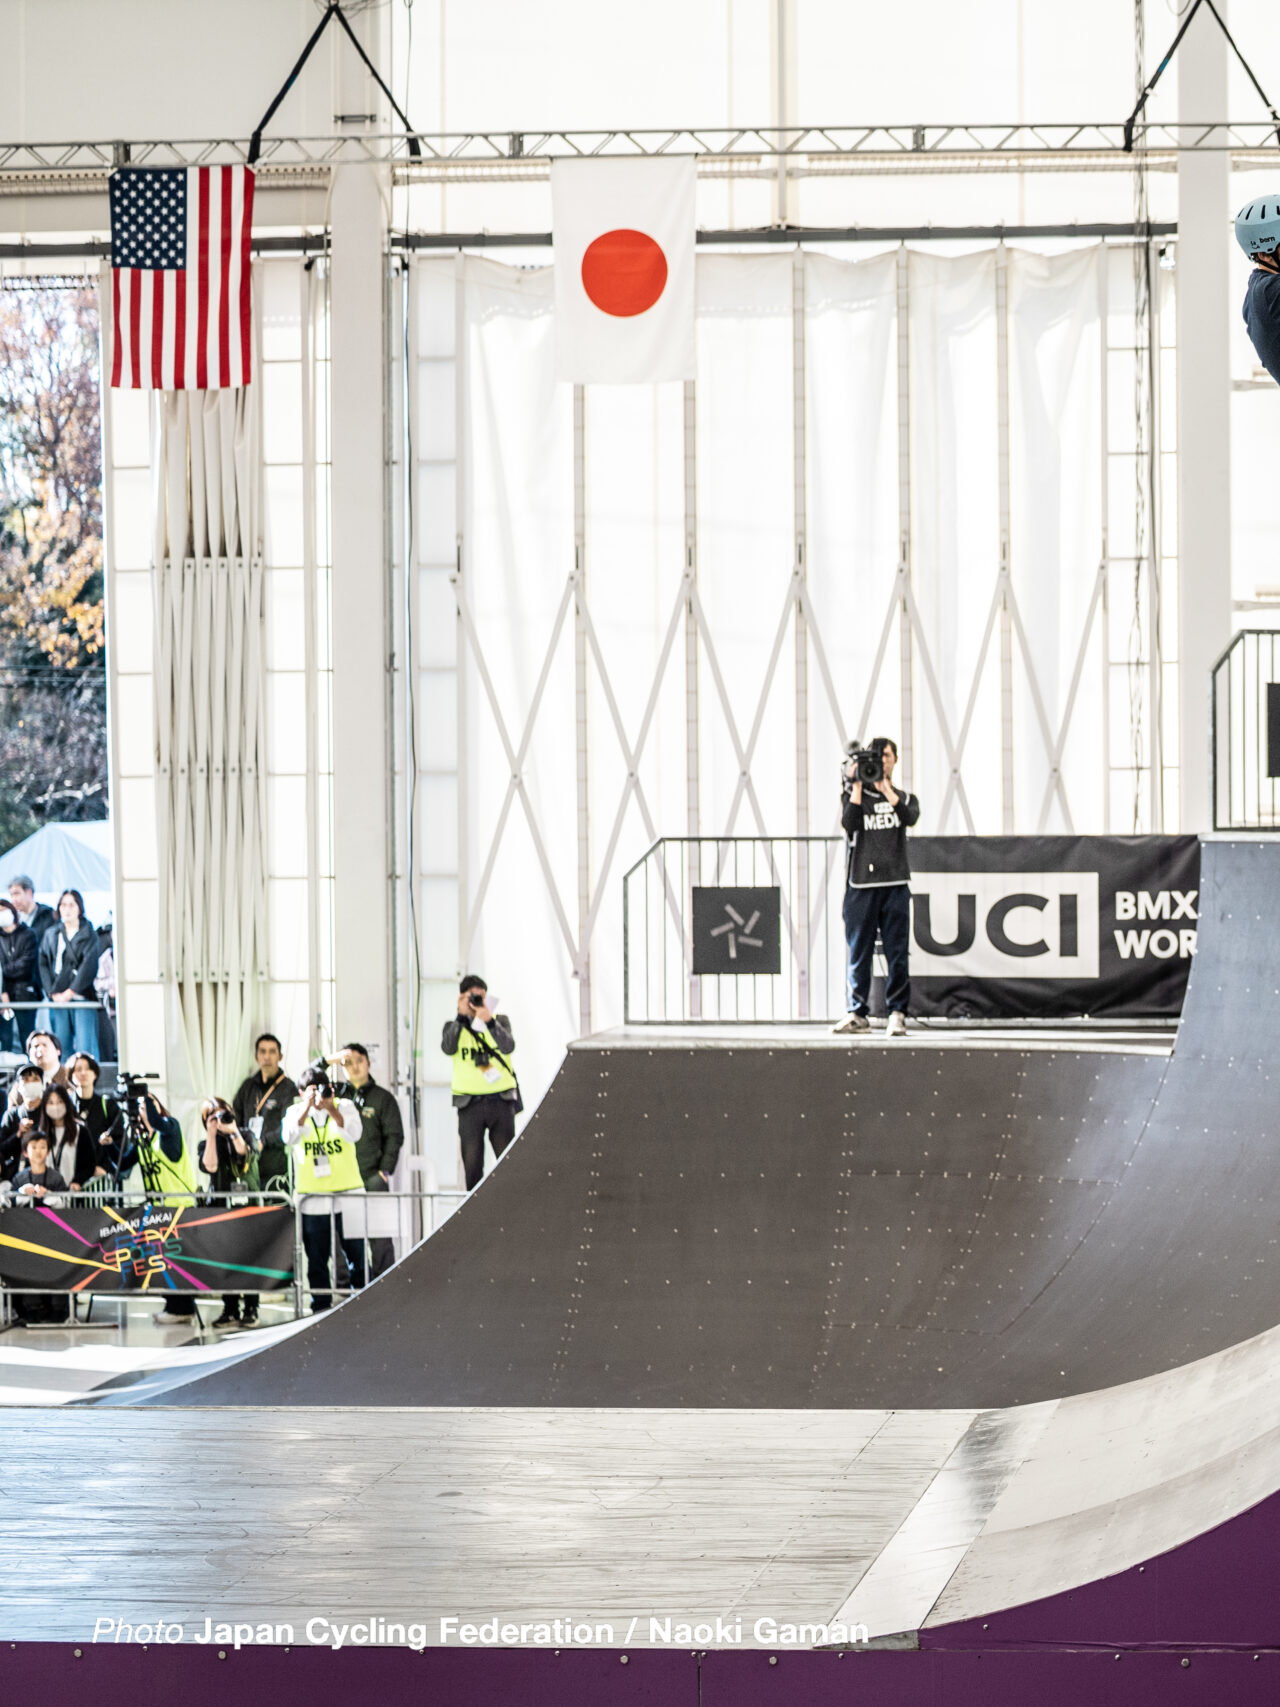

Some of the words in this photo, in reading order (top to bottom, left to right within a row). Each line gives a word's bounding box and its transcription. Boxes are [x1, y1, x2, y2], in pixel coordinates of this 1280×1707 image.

[863, 812, 901, 831] MEDI
[1115, 890, 1199, 920] BMX
[911, 893, 1078, 957] UCI
[100, 1218, 140, 1238] IBARAKI
[142, 1212, 172, 1227] SAKAI
